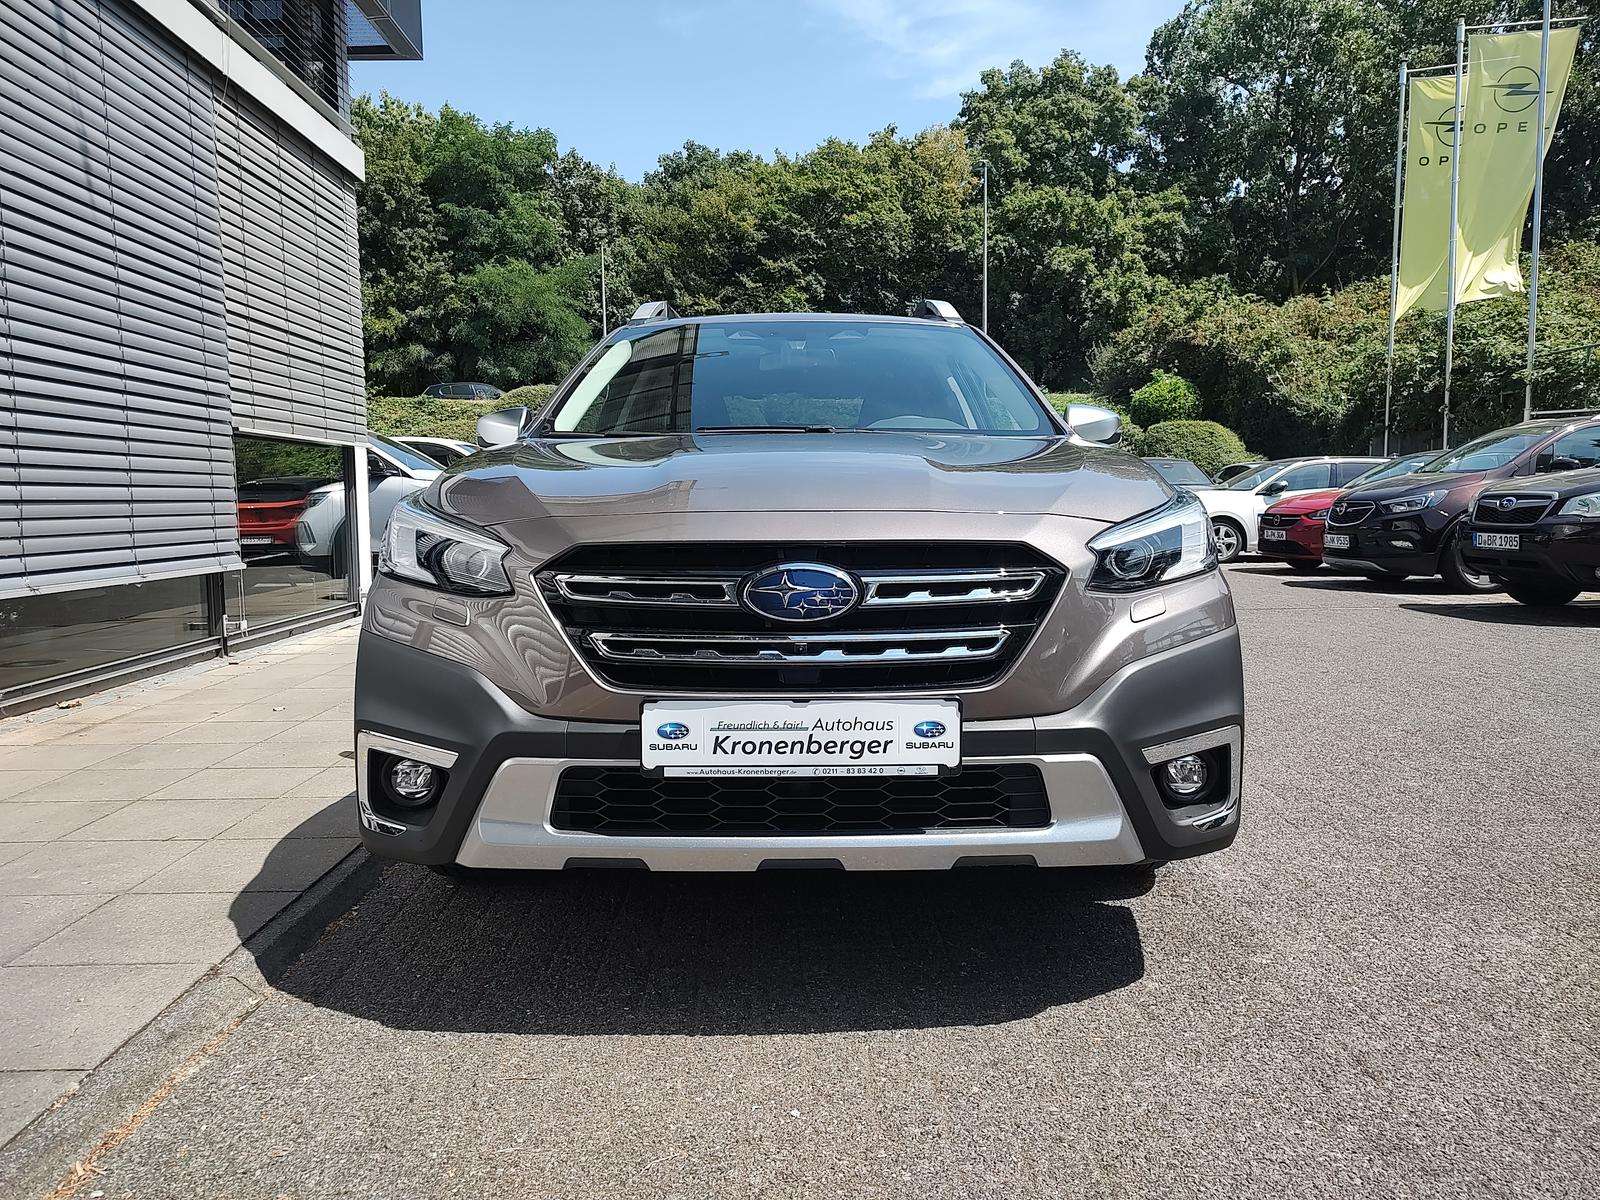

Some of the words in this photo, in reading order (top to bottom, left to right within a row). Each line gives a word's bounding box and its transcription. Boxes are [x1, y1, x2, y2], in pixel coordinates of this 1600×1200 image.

[1474, 122, 1550, 134] OPE
[1419, 156, 1449, 167] OP
[1498, 535, 1518, 547] 1985
[717, 720, 770, 730] Freundlich
[772, 721, 780, 730] &
[782, 720, 803, 731] fair!
[812, 716, 894, 731] Autohaus
[649, 743, 698, 751] SUBARU
[712, 733, 893, 759] Kronenberger
[905, 741, 954, 749] SUBARU
[822, 767, 838, 775] 0211
[846, 767, 855, 775] 83
[857, 767, 866, 775] 83
